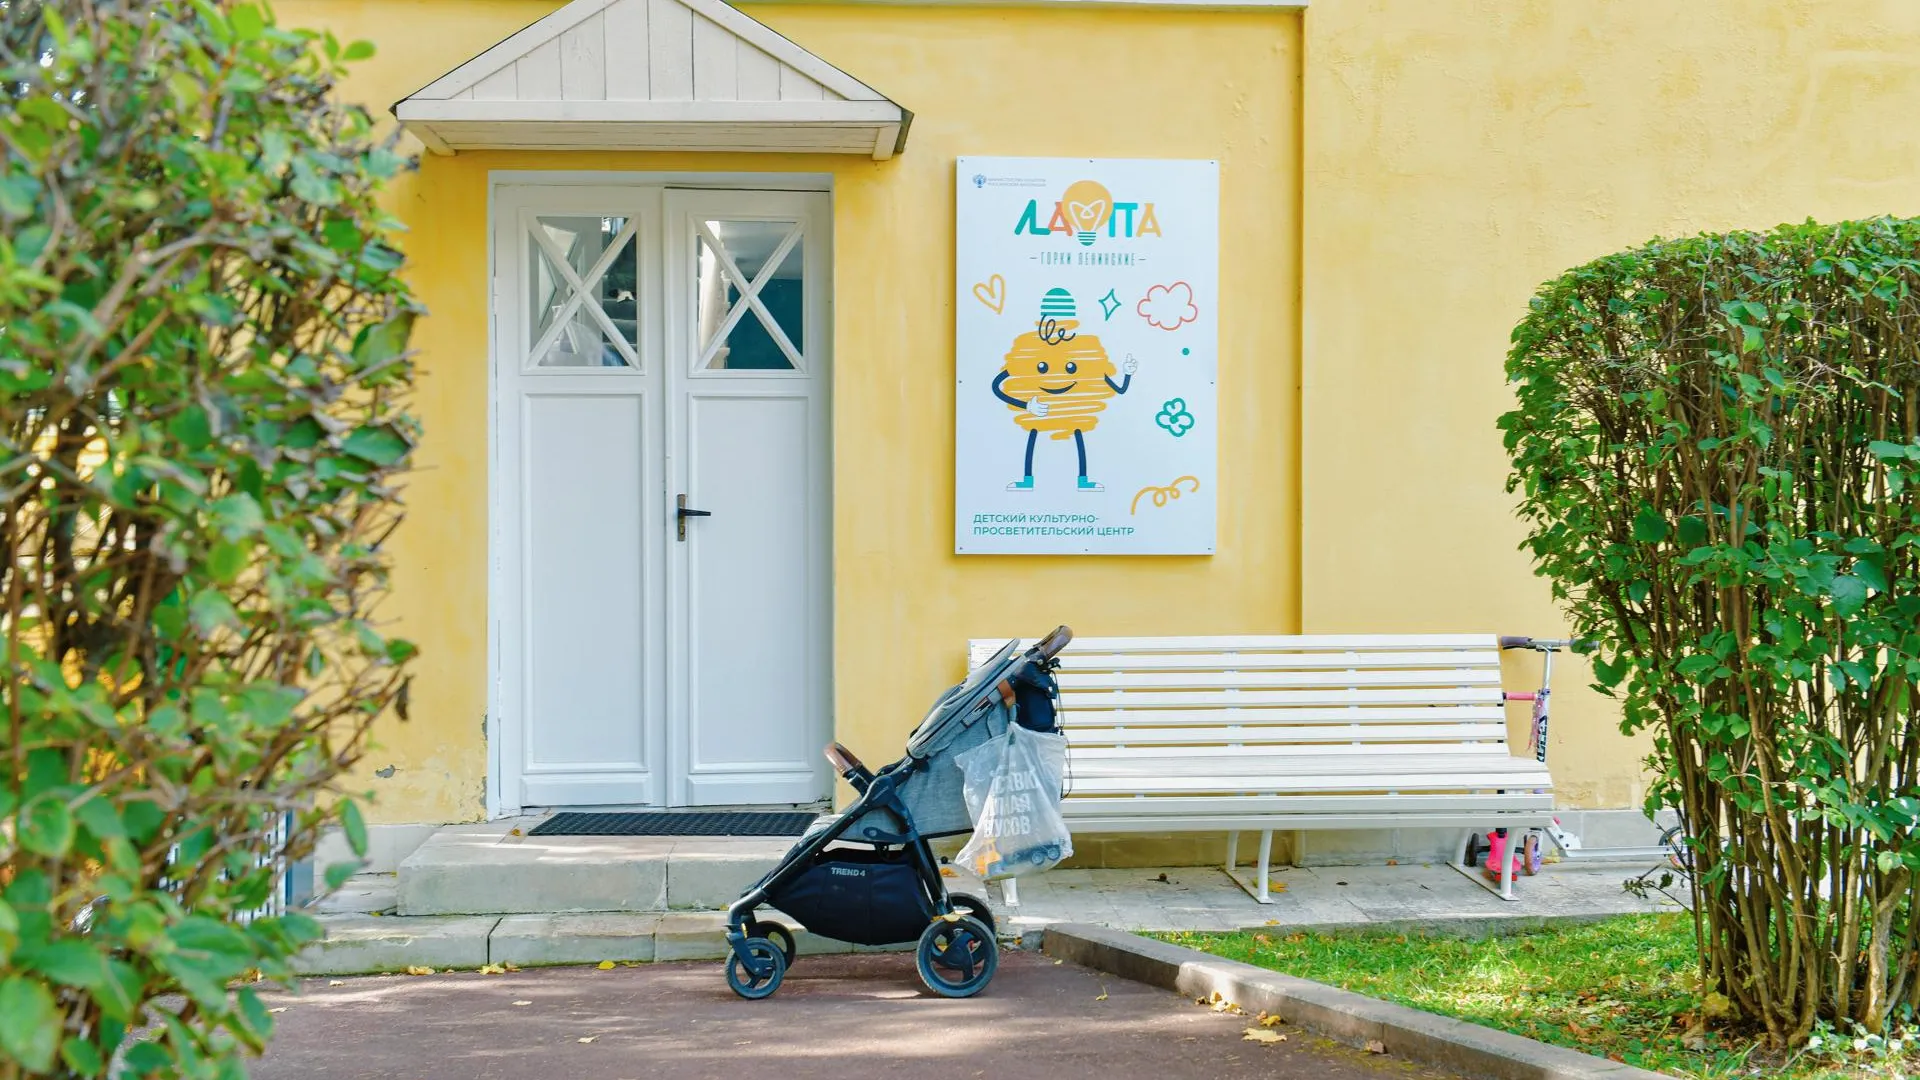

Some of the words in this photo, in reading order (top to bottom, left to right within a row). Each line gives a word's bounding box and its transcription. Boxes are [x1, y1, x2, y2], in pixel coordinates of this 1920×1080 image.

[1040, 251, 1072, 265] ГОРКИ
[1078, 252, 1136, 267] ЛЕНИНСКИЕ
[973, 513, 1027, 524] ДЕТСКИЙ
[1029, 513, 1100, 524] КУЛЬТУРНО-
[973, 525, 1094, 536] ПРОСВЕТИТЕЛЬСКИЙ
[1097, 526, 1135, 537] ЦЕНТР
[831, 866, 860, 877] TREND
[860, 869, 866, 877] 4
